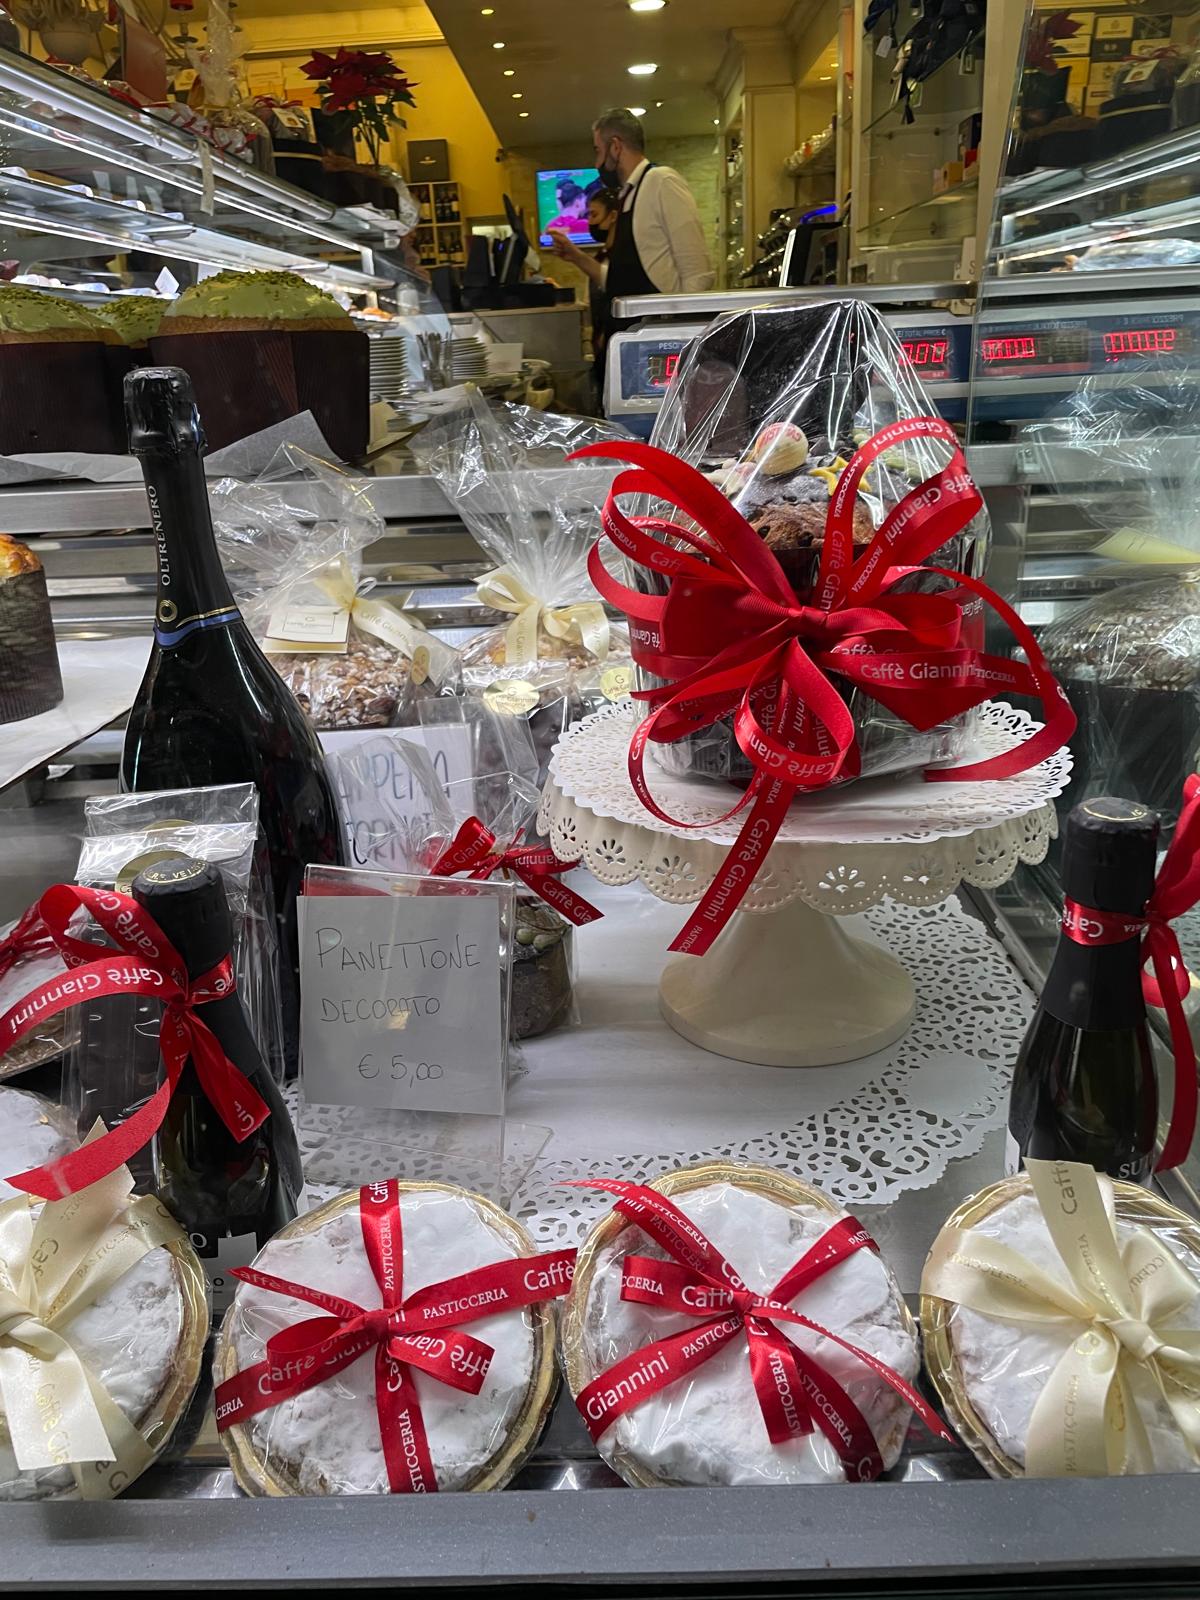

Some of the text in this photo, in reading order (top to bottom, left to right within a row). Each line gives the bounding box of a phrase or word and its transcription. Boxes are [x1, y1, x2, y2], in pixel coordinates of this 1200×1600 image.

[148, 485, 171, 586] OLTRENERO
[884, 488, 942, 546] Giannini
[861, 663, 905, 680] Caffè
[909, 658, 977, 680] Giannini
[738, 818, 770, 863] Caffè
[542, 881, 573, 909] Caffè
[703, 863, 747, 923] Giannini
[117, 910, 160, 959] Caffè
[315, 927, 482, 972] PANETTONE
[8, 973, 102, 1035] Giannini
[106, 967, 164, 988] Caffè
[319, 995, 442, 1024] DECORATO
[357, 1053, 445, 1089] € 5,00
[639, 1195, 710, 1252] PASTICCERIA
[380, 1214, 395, 1291] PASTICCERIA
[422, 1259, 577, 1320] PASTICCERIA Caffè
[585, 1349, 671, 1422] Giannini
